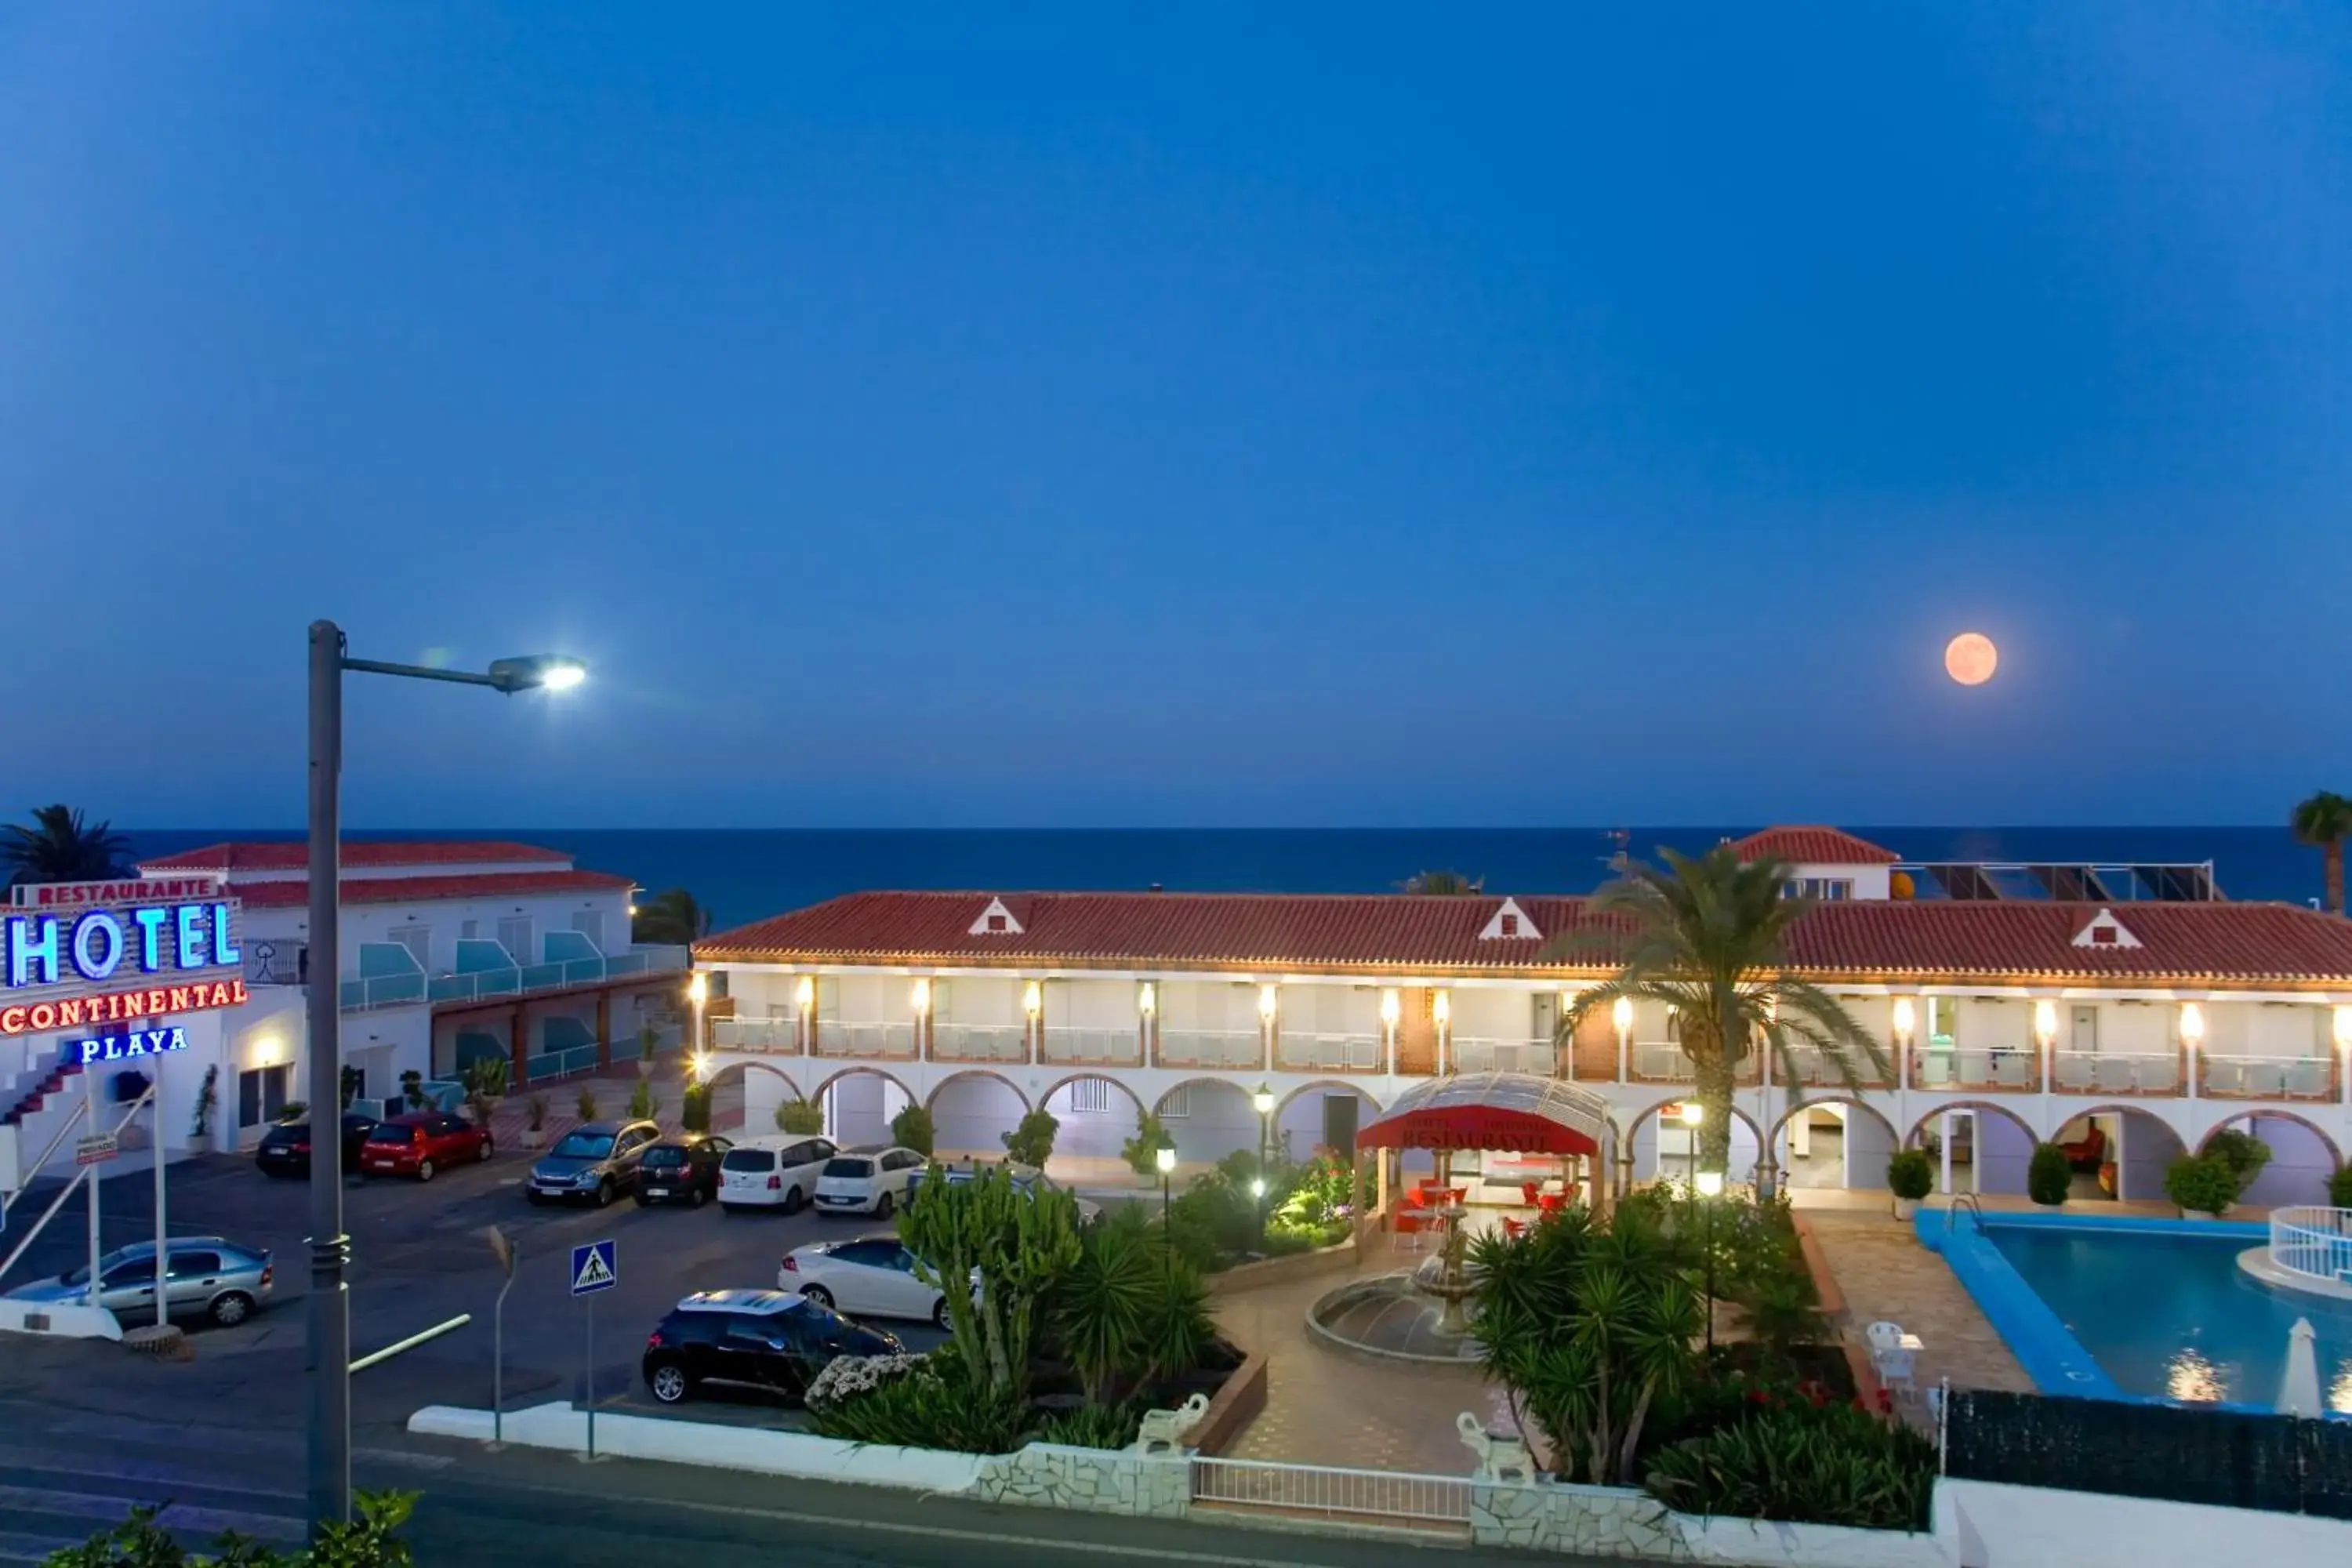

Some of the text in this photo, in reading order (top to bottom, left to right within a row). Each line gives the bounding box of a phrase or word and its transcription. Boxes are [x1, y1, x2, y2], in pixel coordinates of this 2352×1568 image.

[38, 879, 209, 904] RESTAURANTE
[6, 903, 240, 987] HOTEL
[1, 979, 248, 1035] CONTINENTAL
[81, 1028, 187, 1063] PLAYA
